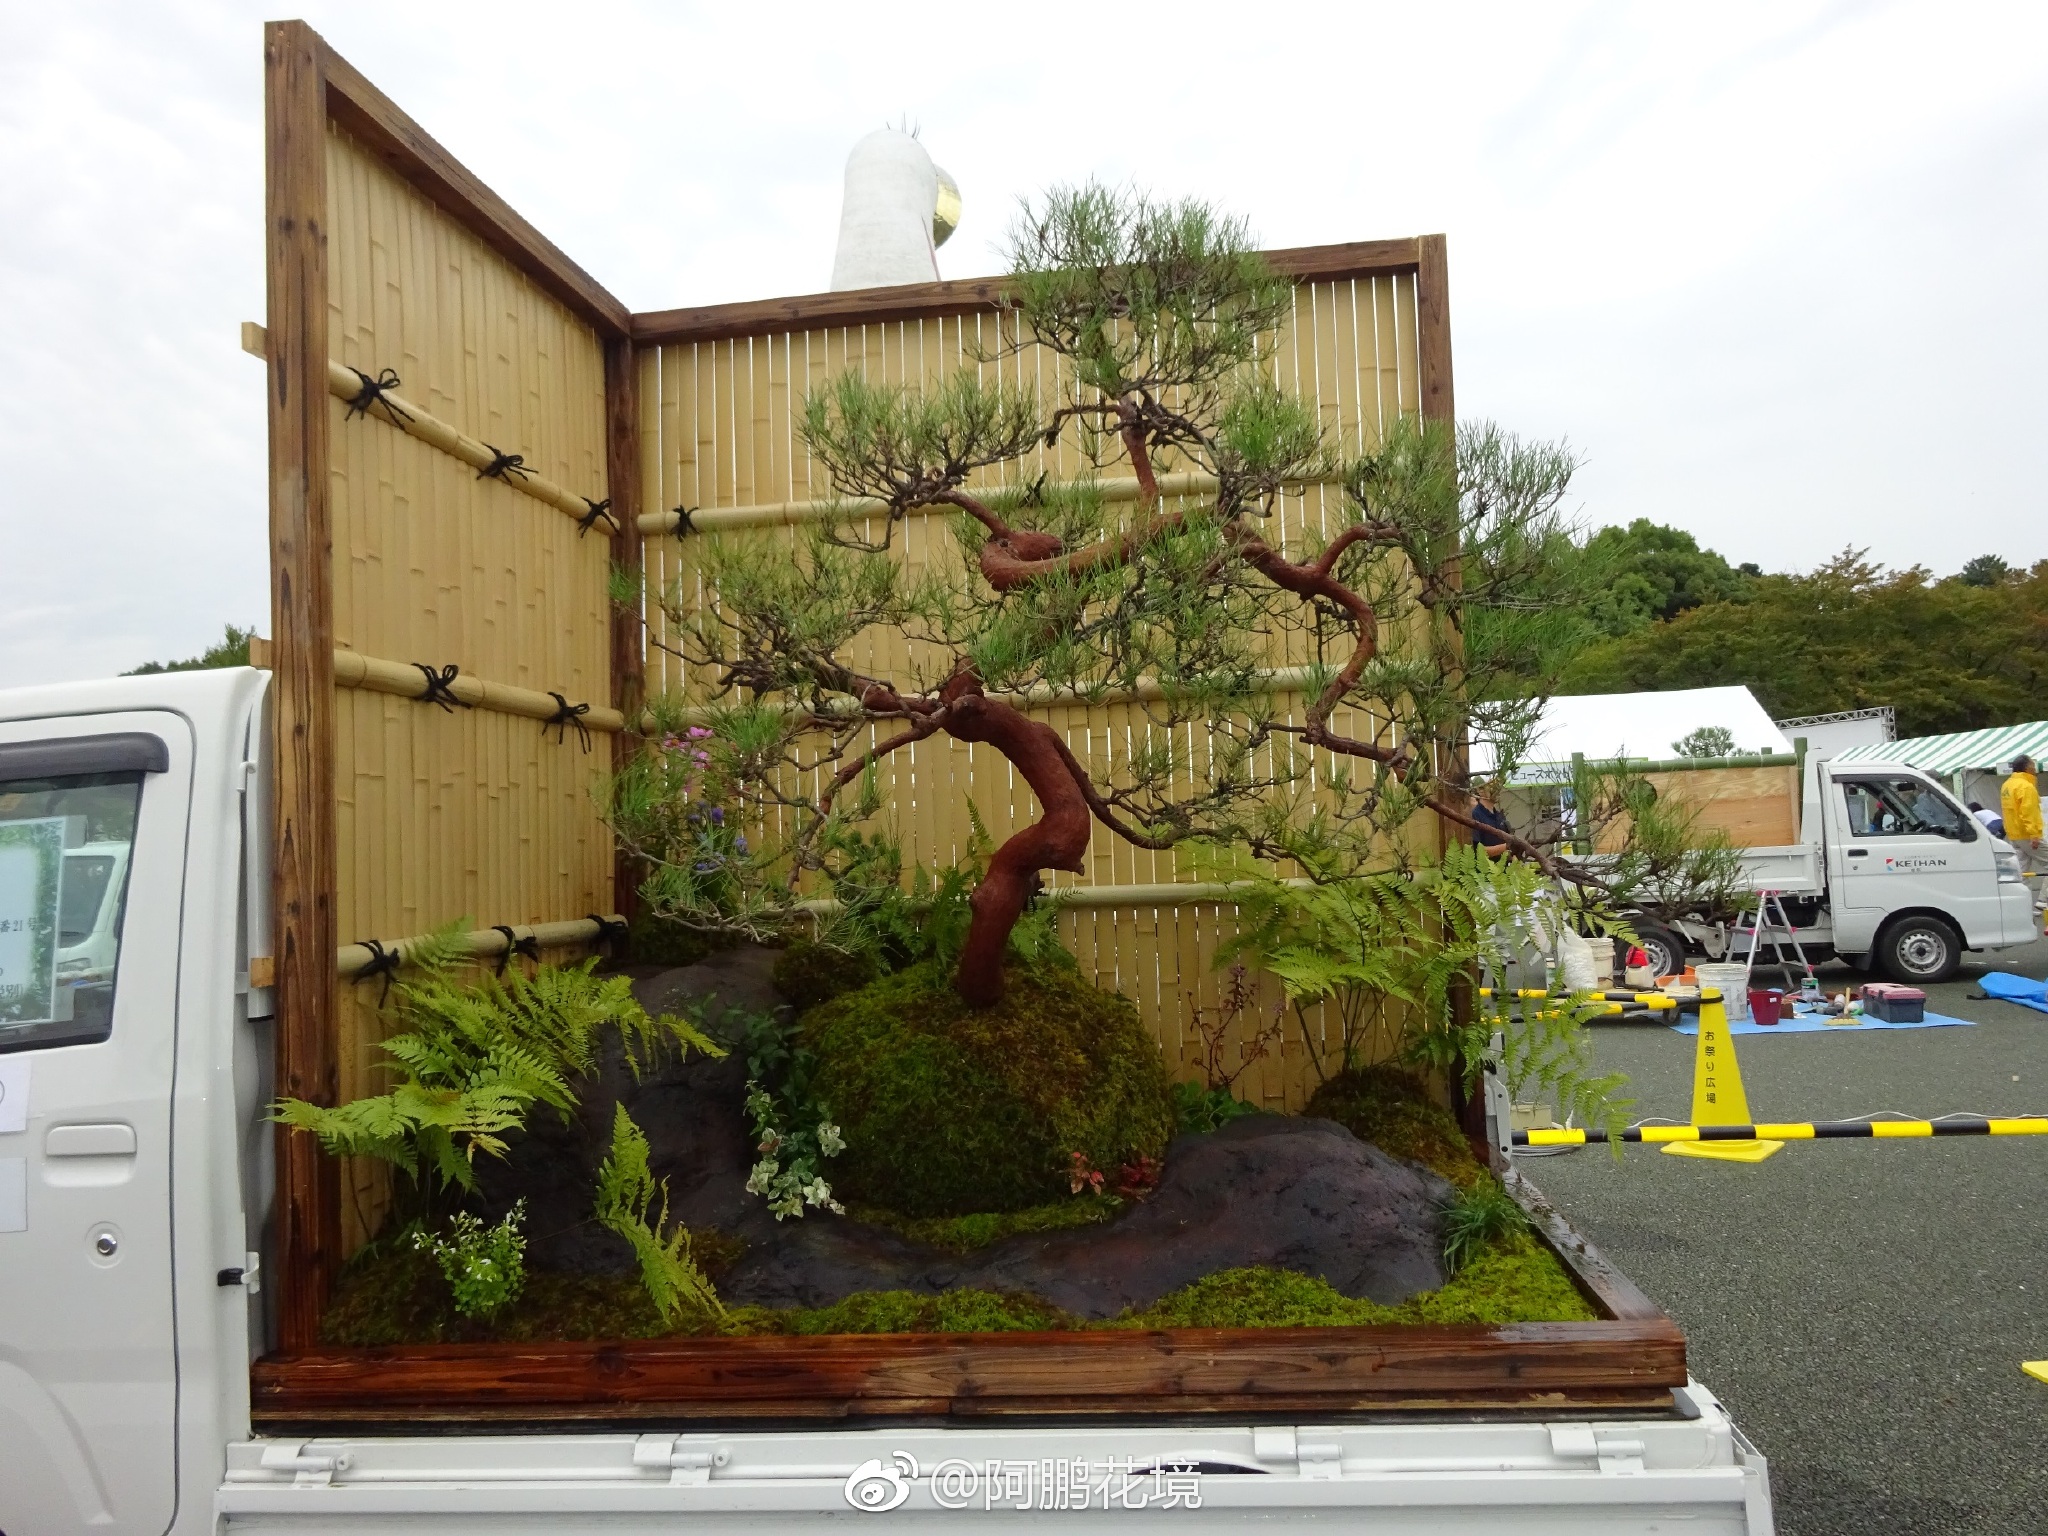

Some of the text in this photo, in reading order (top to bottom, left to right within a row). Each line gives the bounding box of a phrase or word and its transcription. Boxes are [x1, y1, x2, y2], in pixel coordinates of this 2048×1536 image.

[1895, 859, 1947, 868] KEIHAN
[1704, 1031, 1716, 1104] お祭り広場
